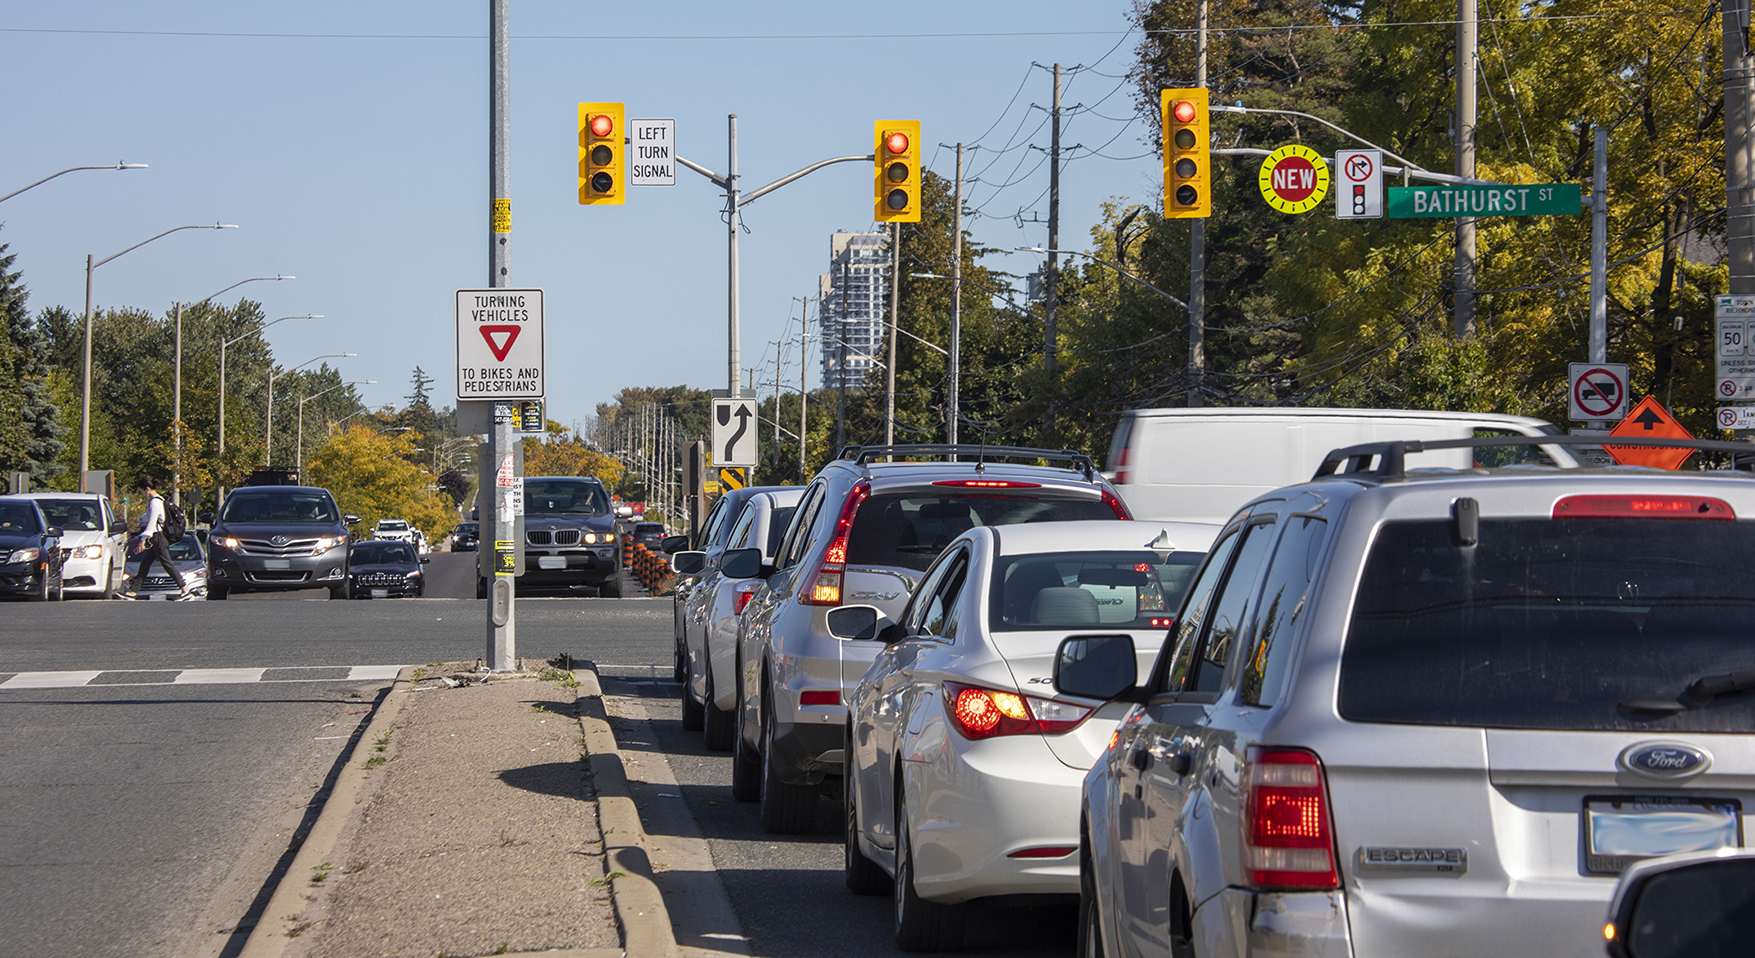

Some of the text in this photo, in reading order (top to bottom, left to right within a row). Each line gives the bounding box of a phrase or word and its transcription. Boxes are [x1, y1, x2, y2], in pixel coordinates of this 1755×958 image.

[639, 127, 667, 140] LEFT
[638, 146, 668, 159] TURN
[633, 164, 673, 178] SIGNAL
[1273, 168, 1314, 190] NEW
[1414, 187, 1554, 214] BATHURST ST
[474, 295, 526, 308] TURNING
[471, 309, 529, 322] VEHICLES
[1724, 332, 1741, 346] 50
[462, 368, 539, 380] TO BIKES AND
[464, 380, 537, 392] PEDESTRIANS
[1647, 750, 1688, 768] Ford
[1369, 849, 1460, 863] ESCAPE
